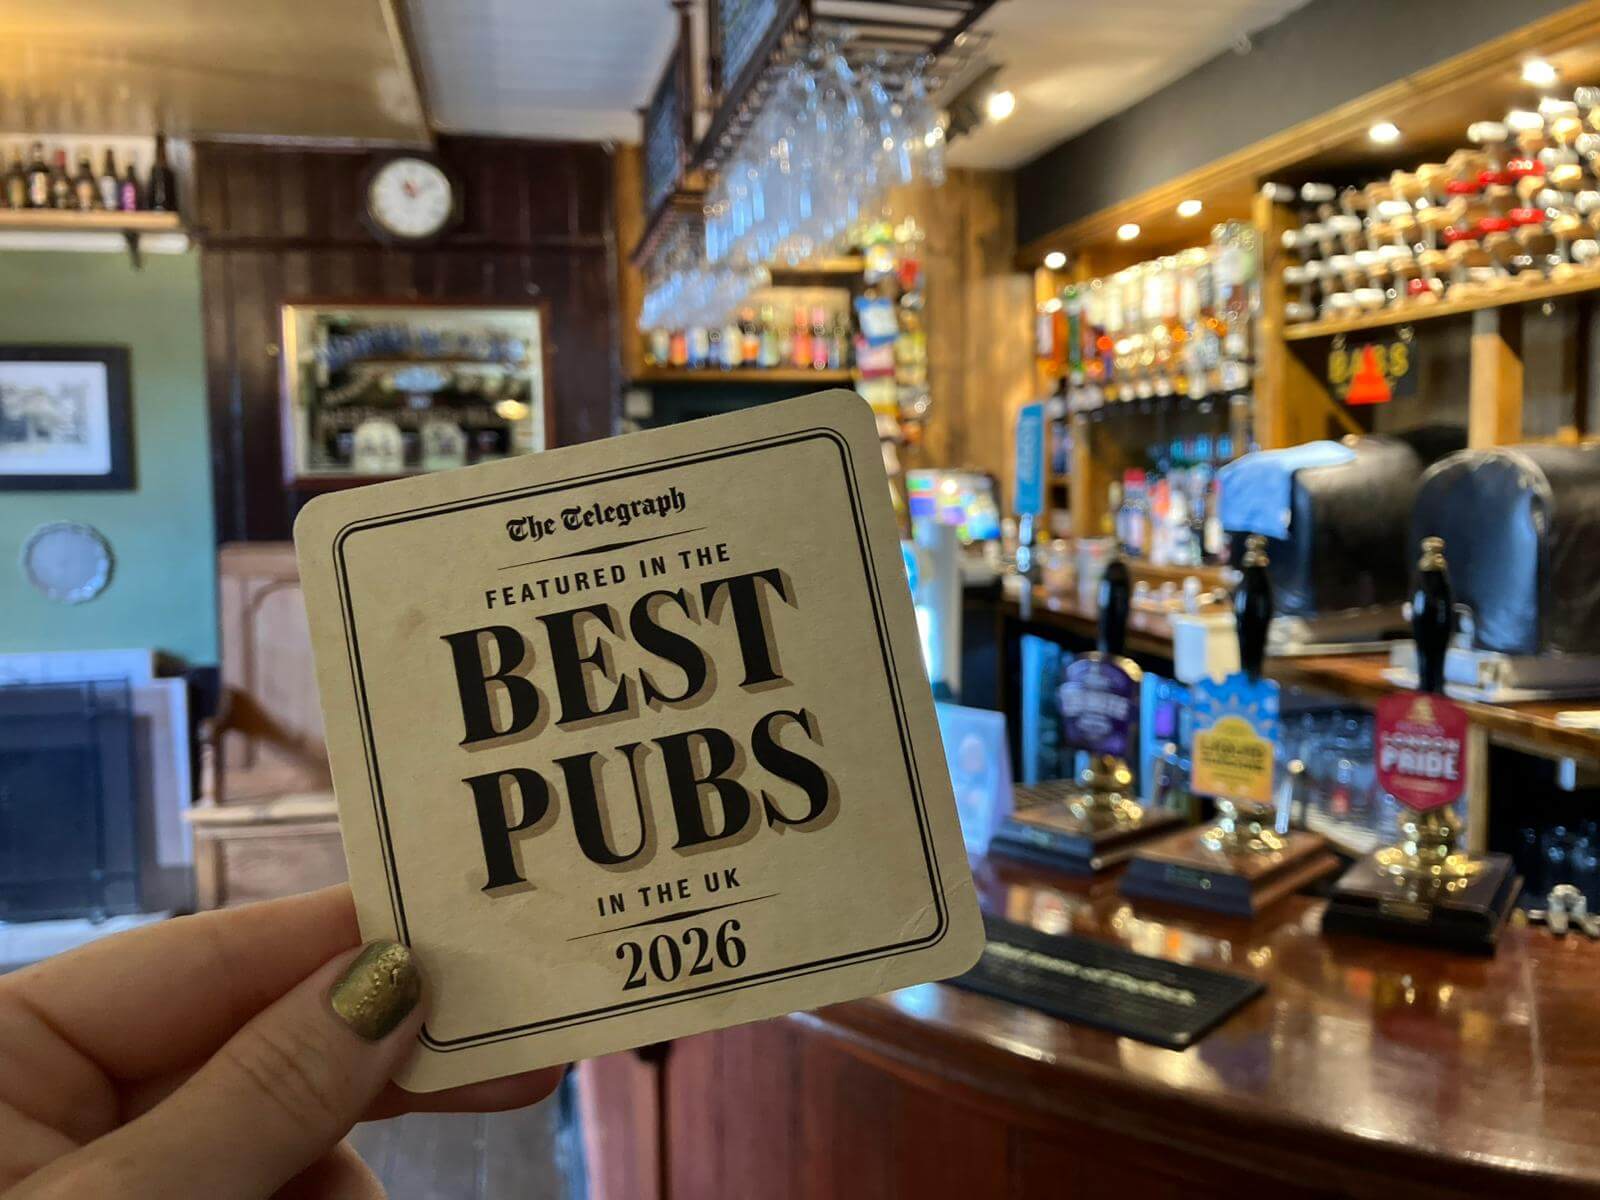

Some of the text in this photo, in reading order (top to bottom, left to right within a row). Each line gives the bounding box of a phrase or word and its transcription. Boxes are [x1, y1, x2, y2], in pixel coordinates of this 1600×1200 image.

[505, 486, 687, 543] The Telegraph
[485, 543, 731, 610] FEATURED IN THE
[440, 567, 799, 753] BEST
[1381, 745, 1459, 780] PRIDE
[461, 707, 841, 899] PUBS
[597, 867, 741, 917] IN THE UK
[615, 919, 747, 992] 2026
